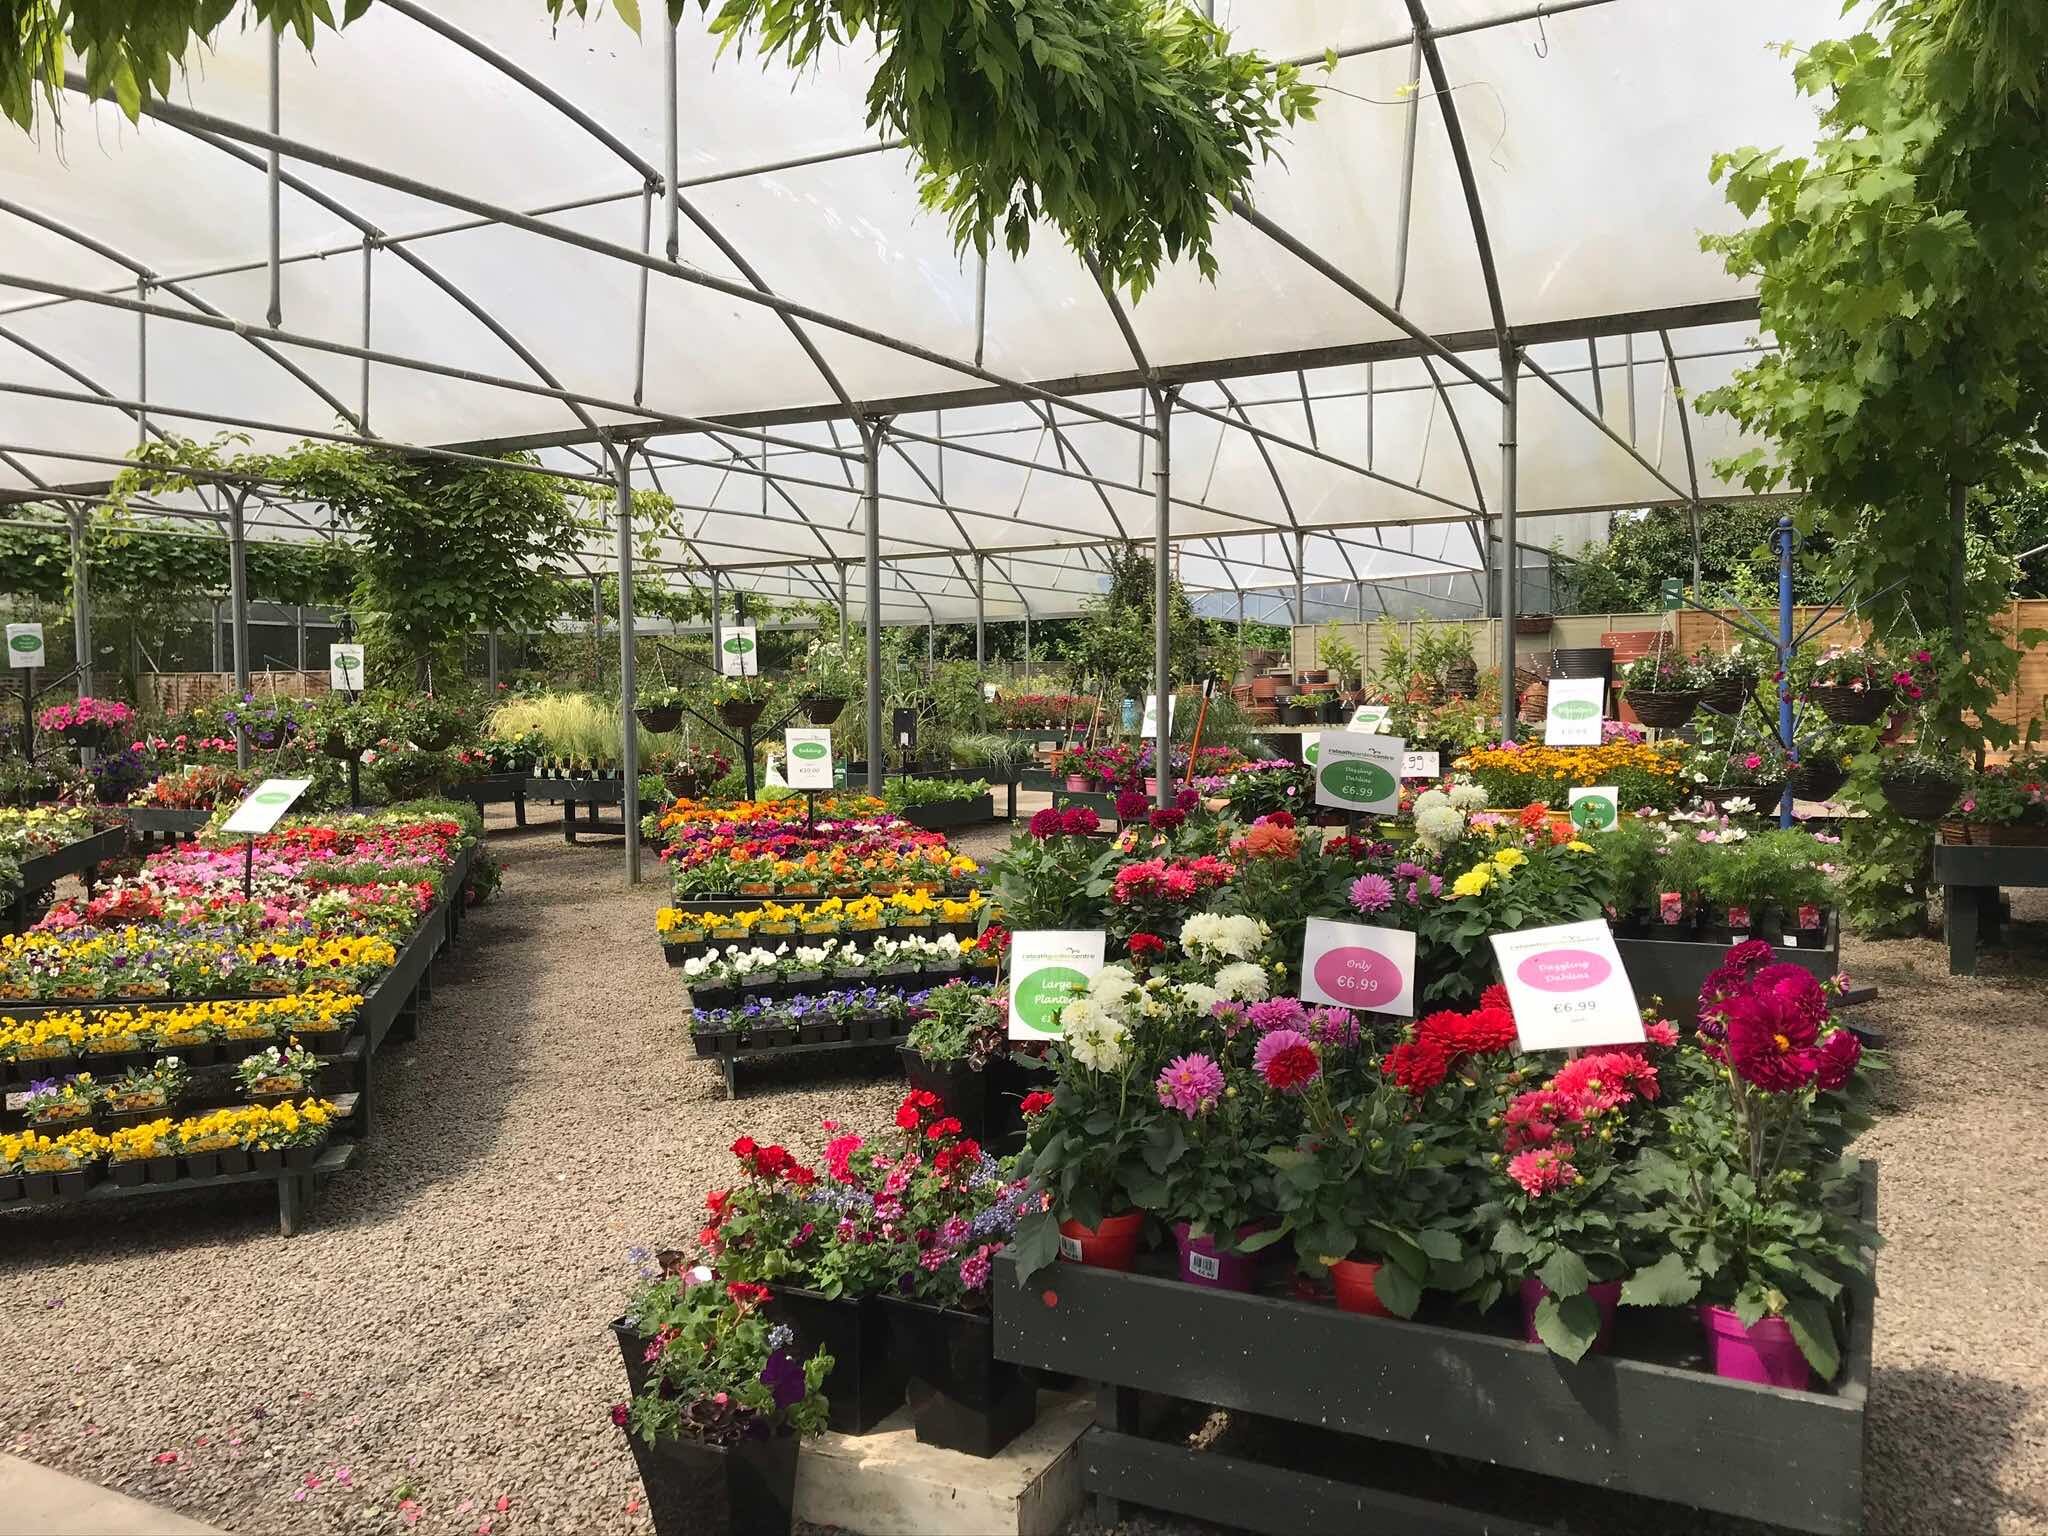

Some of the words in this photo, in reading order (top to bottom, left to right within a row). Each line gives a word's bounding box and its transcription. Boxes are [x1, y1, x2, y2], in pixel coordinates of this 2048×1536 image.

[1342, 785, 1374, 797] €6.99
[1346, 960, 1372, 973] Only
[1041, 978, 1072, 992] Large
[1337, 975, 1378, 992] €6.99
[1553, 1000, 1597, 1014] €6.99
